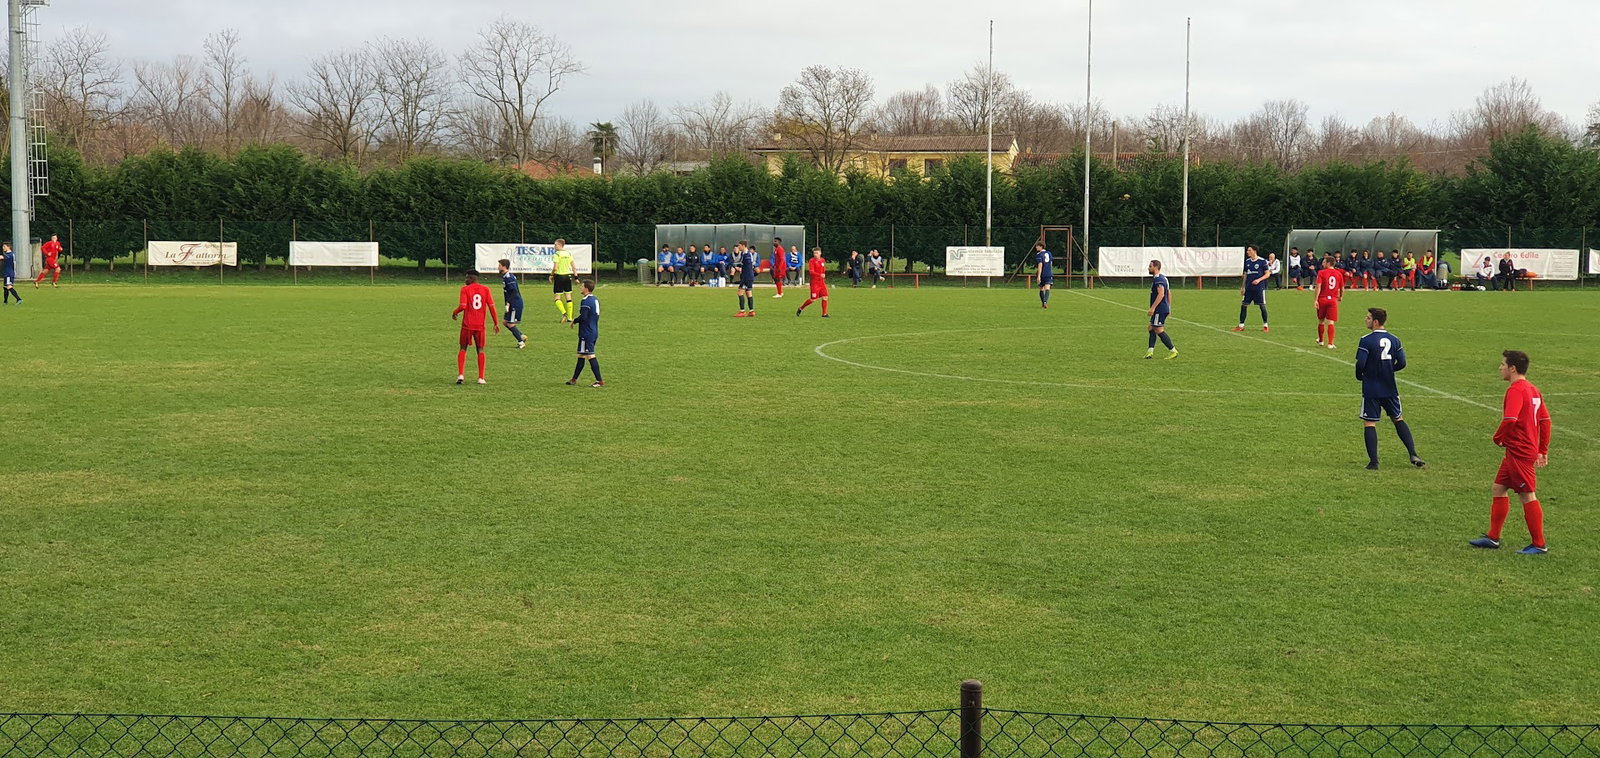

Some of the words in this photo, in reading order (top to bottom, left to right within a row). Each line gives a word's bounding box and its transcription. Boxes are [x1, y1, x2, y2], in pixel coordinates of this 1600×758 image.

[165, 251, 176, 259] La
[1520, 251, 1539, 259] Edile
[1328, 275, 1337, 290] 9
[472, 293, 482, 310] 8
[1379, 337, 1393, 361] 2
[1531, 397, 1542, 427] 7
